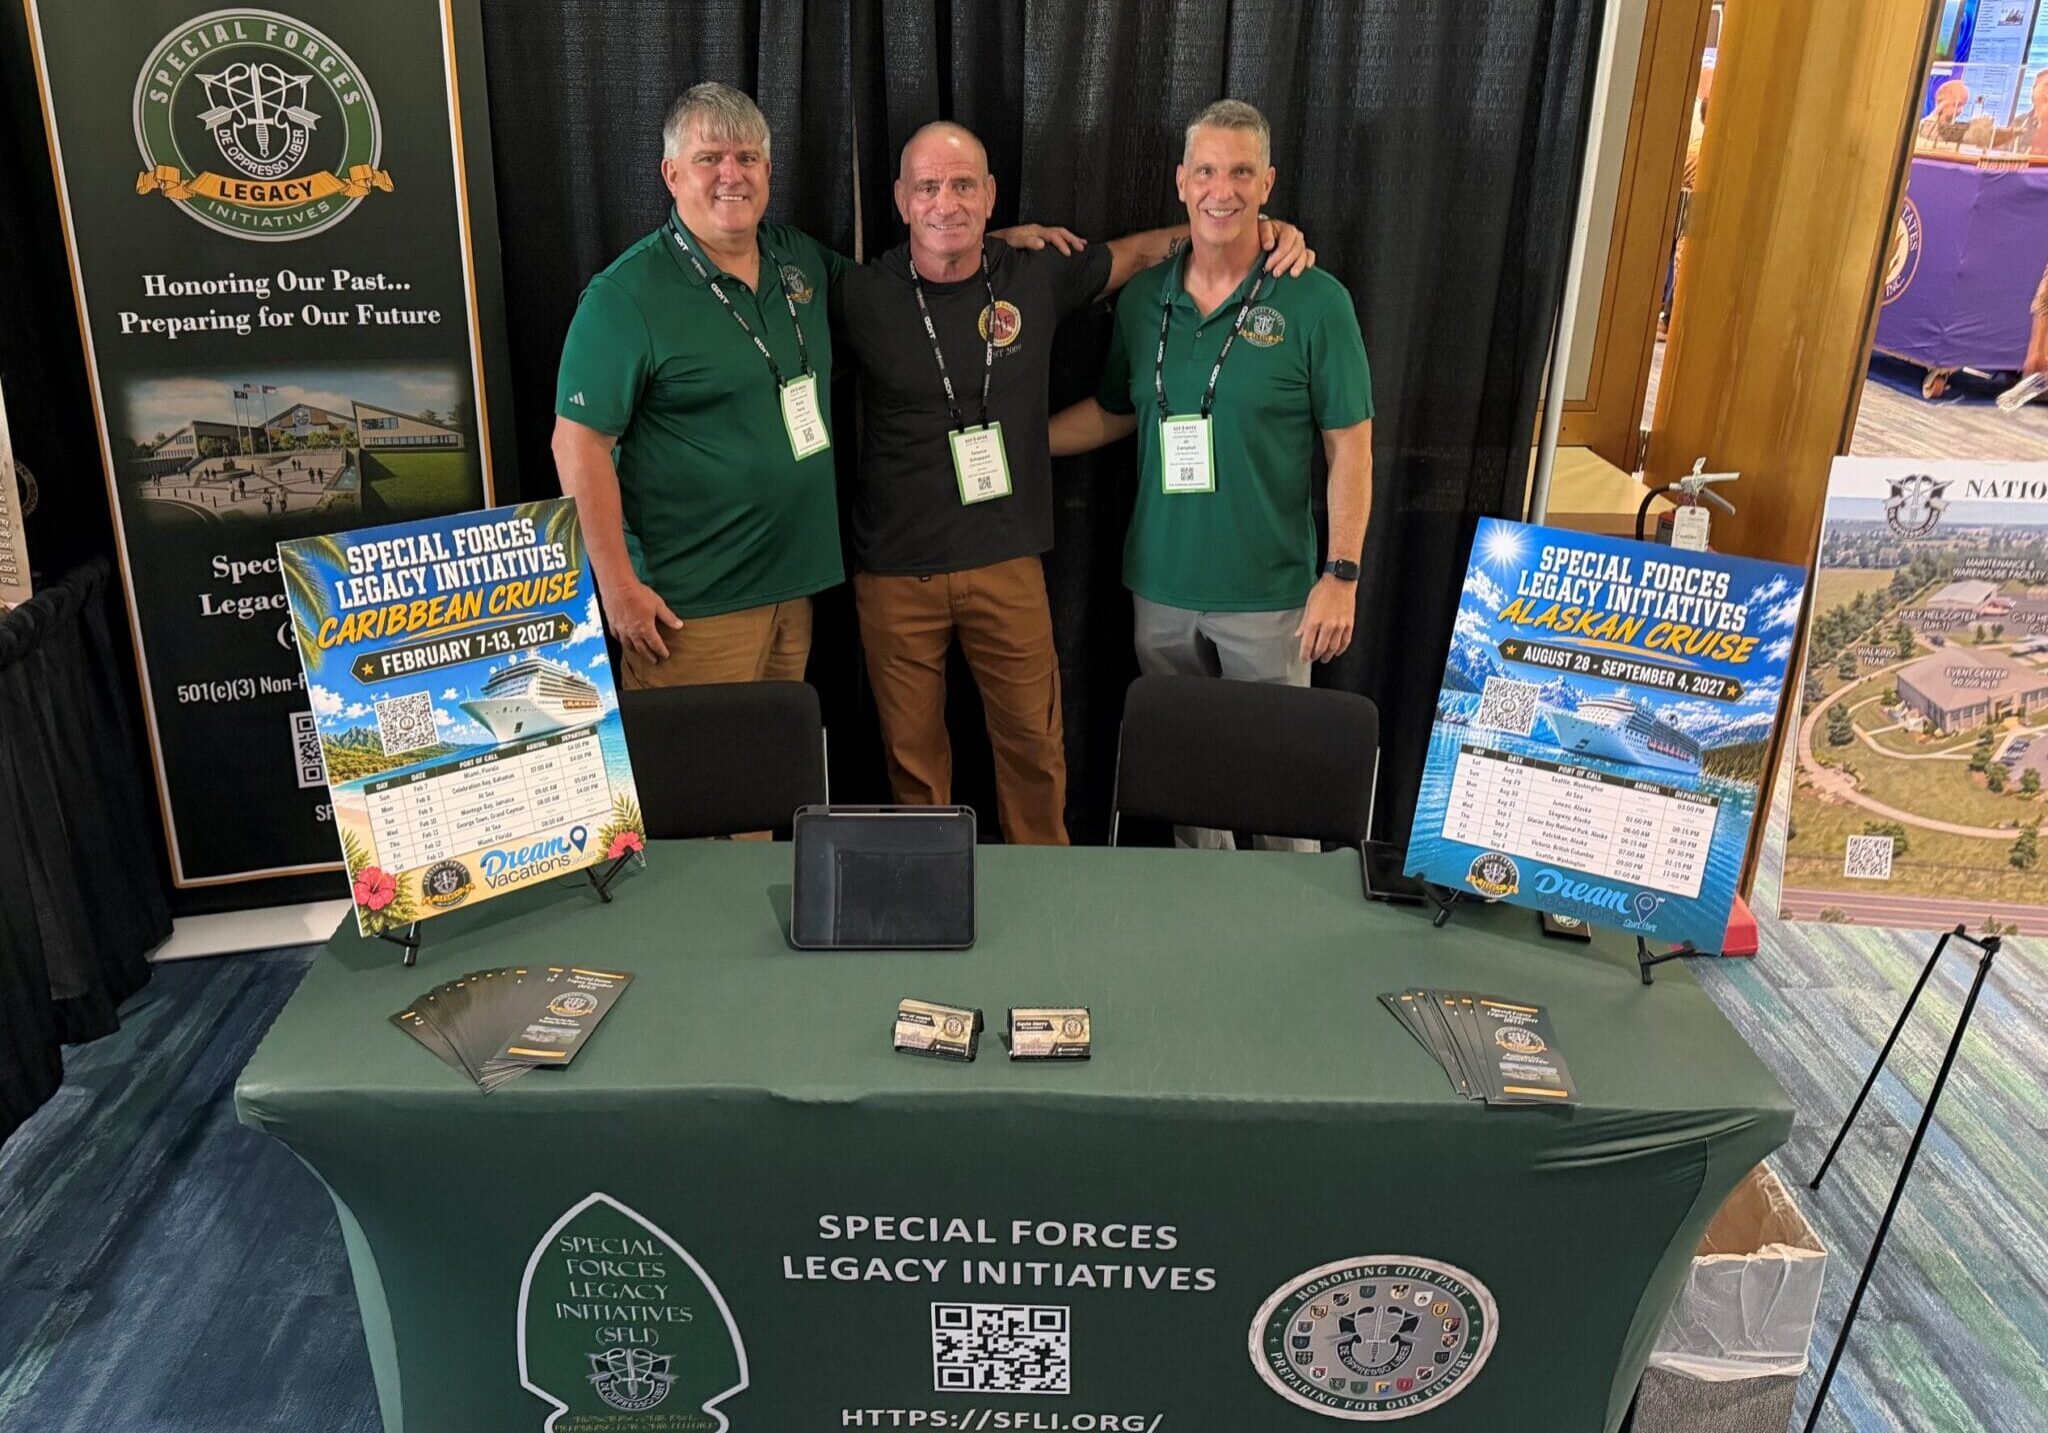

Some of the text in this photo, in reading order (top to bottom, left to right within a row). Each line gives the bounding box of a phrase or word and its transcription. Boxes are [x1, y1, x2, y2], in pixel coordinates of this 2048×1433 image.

[150, 21, 361, 106] SPECIAL FORCES
[218, 128, 305, 176] DE OPPRESSO LIBER
[219, 181, 314, 202] LEGACY
[208, 200, 330, 228] INITIATIVES
[1902, 203, 1919, 251] TATES
[143, 269, 411, 299] Honoring Our Past...
[118, 304, 441, 339] Preparing for Our Future
[346, 518, 536, 575] SPECIAL FORCES
[1965, 558, 2026, 568] MAINTENANCE
[335, 542, 567, 610] LEGACY INITIATIVES
[1539, 545, 1730, 599] SPECIAL FORCES
[1952, 568, 2047, 580] WAREHOUSE FACILITY
[318, 588, 484, 649] CARIBBEAN
[488, 570, 580, 612] CRUISE
[1517, 570, 1749, 632] LEGACY INITIATIVES
[380, 621, 555, 676] FEBRUARY 7-13, 2027
[1498, 597, 1760, 664] ALASKAN CRUISE
[1857, 647, 1897, 658] WALKING
[1523, 645, 1572, 670] AUGUST
[1574, 654, 1590, 671] 28
[1600, 660, 1676, 690] SEPTEMBER
[1677, 675, 1690, 694] 4,
[1692, 677, 1726, 697] 2027
[178, 678, 255, 703] 501(c)(3)
[376, 781, 389, 791] DAY
[411, 772, 426, 782] DATE
[459, 758, 475, 769] PORT
[475, 756, 483, 765] OF
[484, 753, 499, 763] CALL
[1472, 747, 1712, 805] DAY DATE PORT OF CALL ARRIVAL DEPARTURE
[480, 836, 571, 877] Dream
[485, 855, 571, 889] Vacations
[1534, 868, 1632, 914] Dream
[559, 1236, 663, 1256] SPECIAL
[818, 1214, 1178, 1250] SPECIAL FORCES
[566, 1259, 666, 1278] FORCES
[782, 1255, 1217, 1292] LEGACY INITIATIVES
[1294, 1265, 1470, 1301] HONORING OUR PAST
[569, 1281, 669, 1300] LEGACY
[555, 1302, 693, 1323] INITIATIVES
[595, 1326, 659, 1347] (SFLI)
[1271, 1351, 1473, 1411] PREPARING FOR OUR FUTURE
[841, 1409, 1164, 1433] HTTPS://SFLI.ORG/
